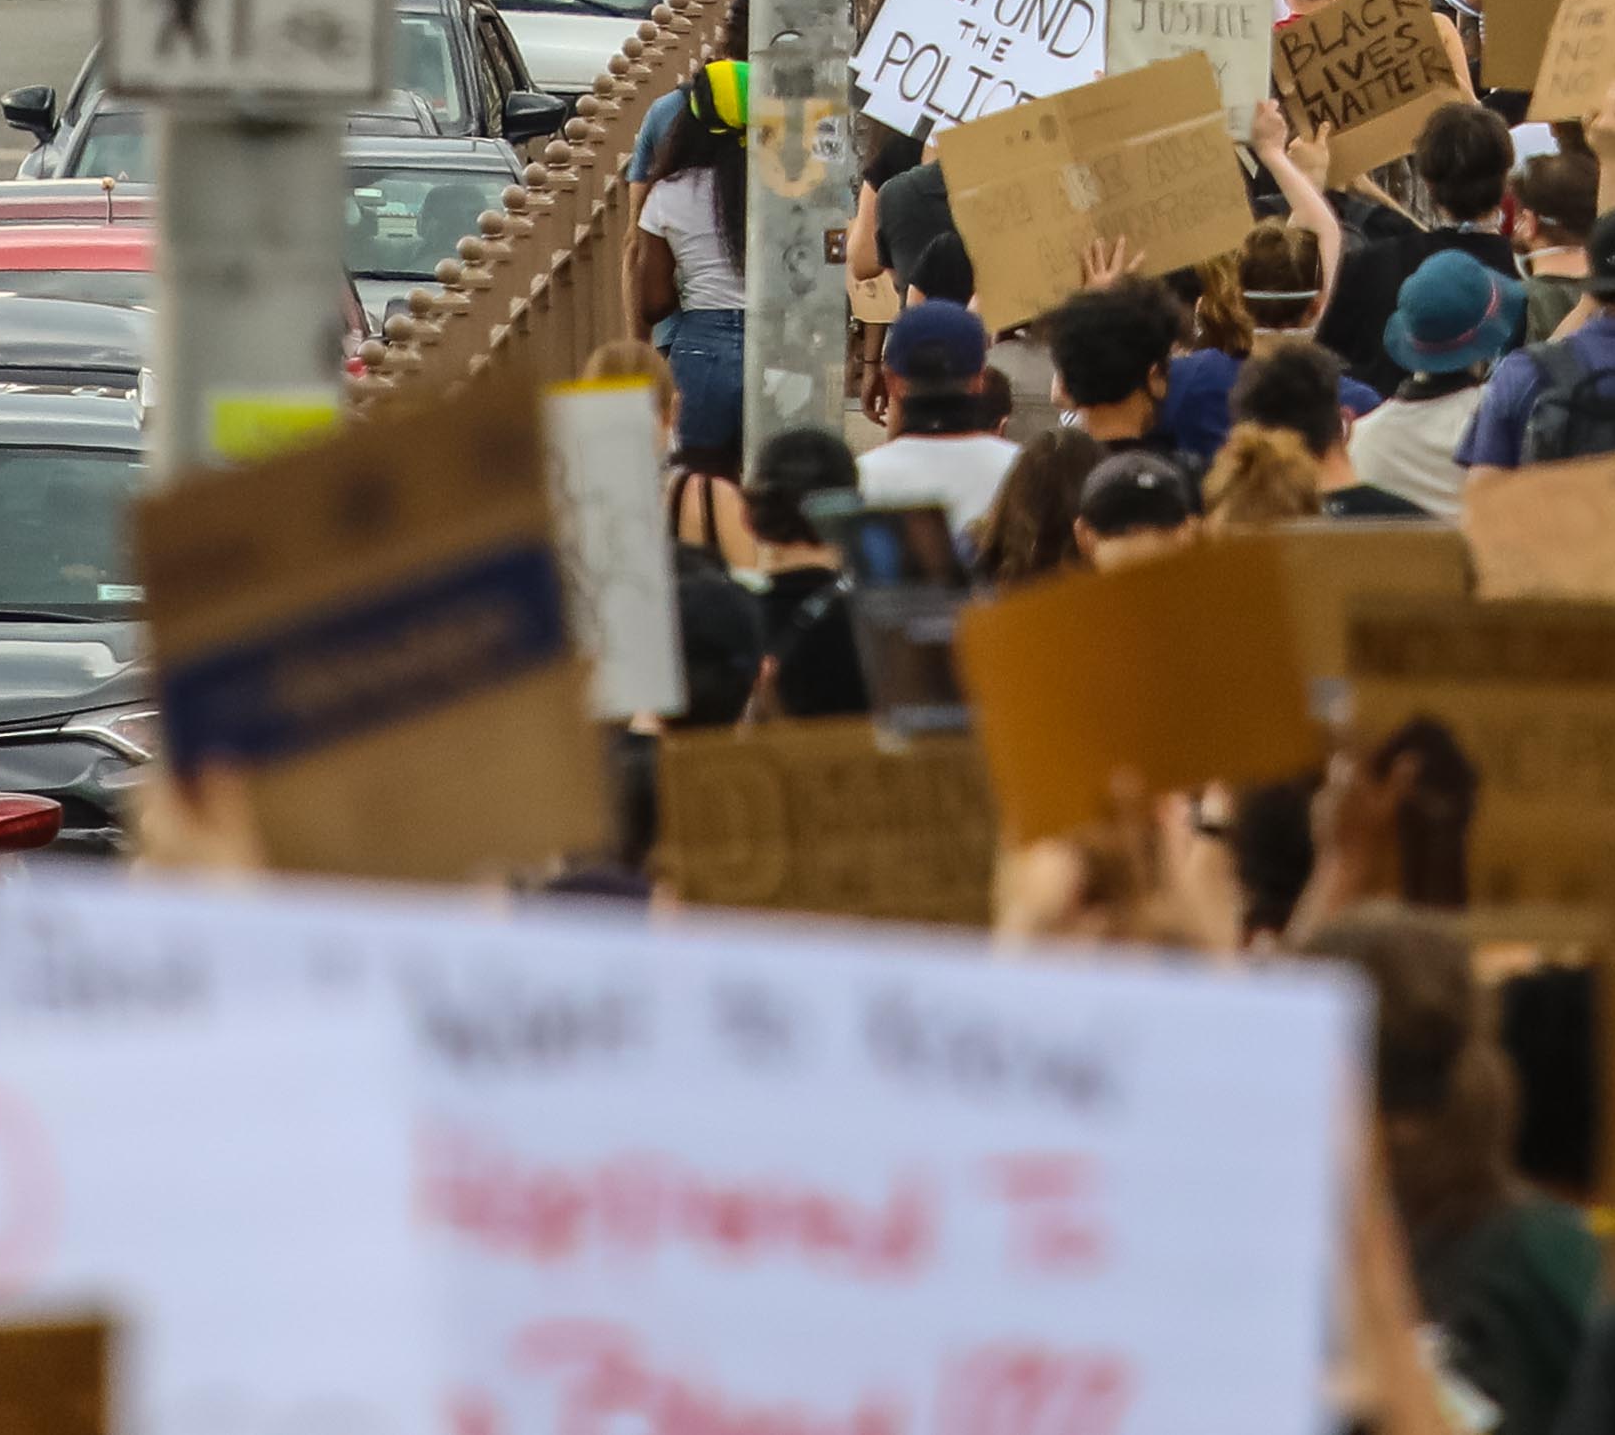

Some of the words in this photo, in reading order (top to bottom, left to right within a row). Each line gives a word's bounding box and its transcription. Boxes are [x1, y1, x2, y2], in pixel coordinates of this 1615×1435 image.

[875, 31, 1040, 124] POLIC
[960, 19, 1013, 64] THE
[1296, 21, 1422, 108] LIVES
[1556, 36, 1604, 62] NO
[1307, 54, 1457, 131] MATTER
